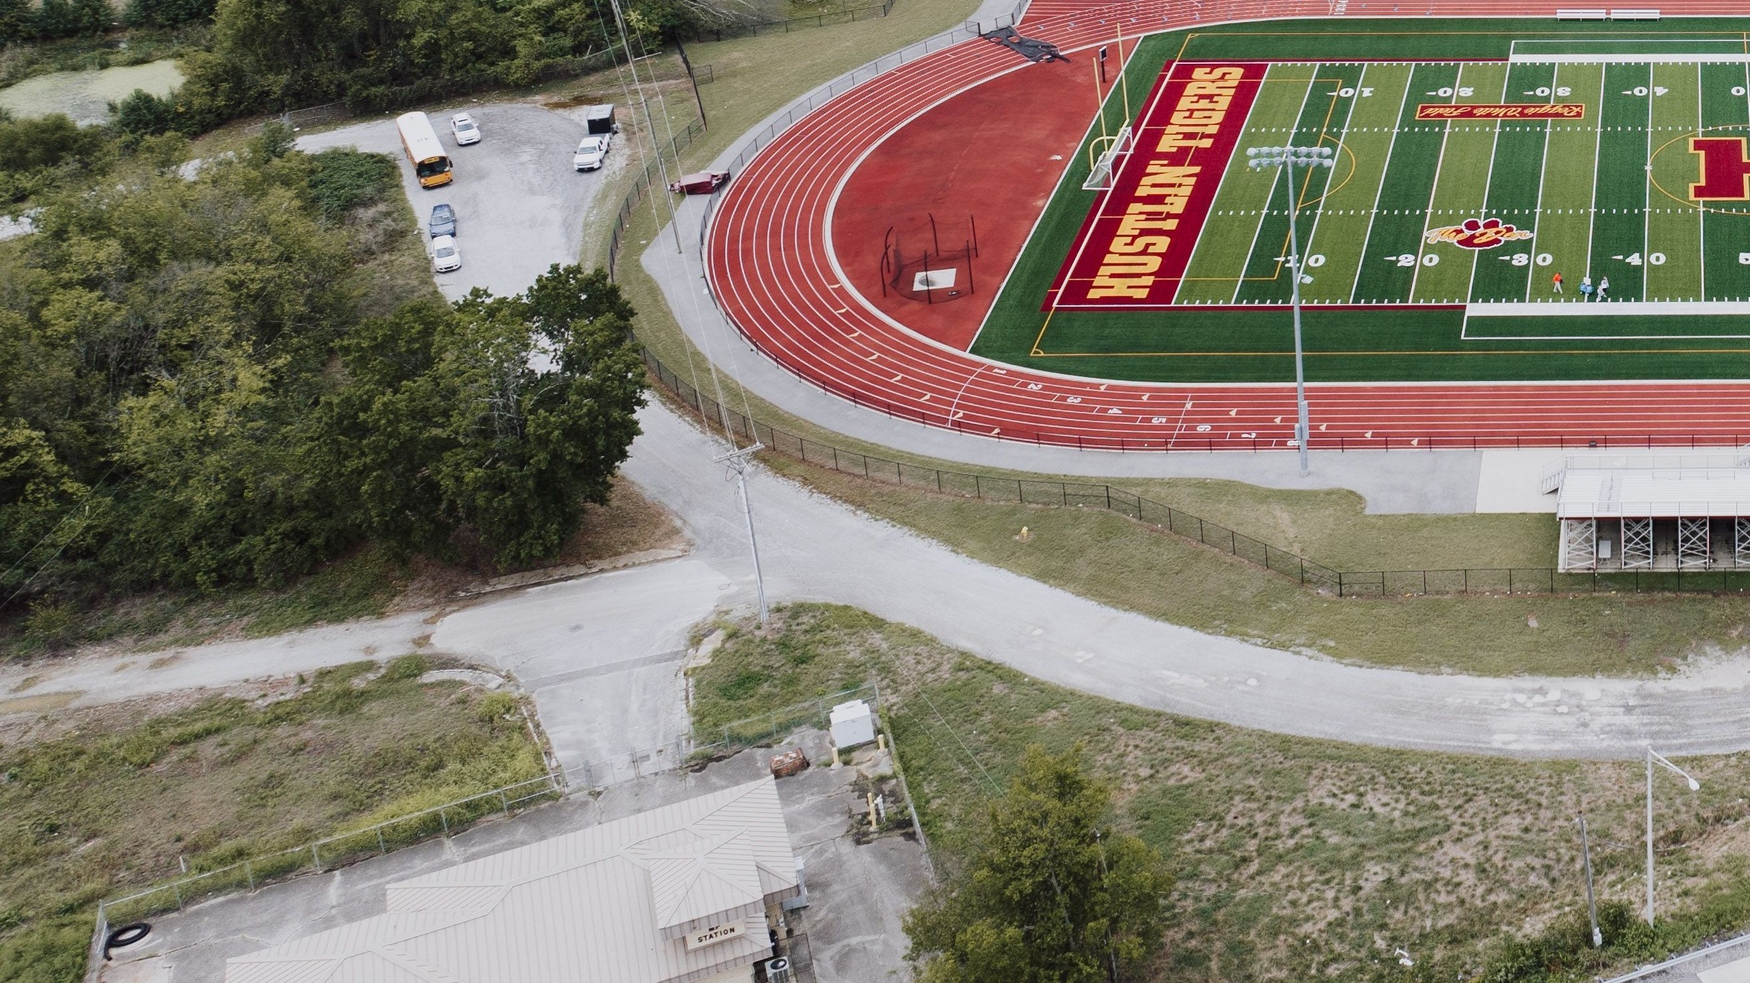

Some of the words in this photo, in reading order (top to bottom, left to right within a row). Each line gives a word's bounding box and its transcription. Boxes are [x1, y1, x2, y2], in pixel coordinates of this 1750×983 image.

[1155, 67, 1245, 153] TIGERS
[1420, 105, 1472, 117] Field
[1473, 105, 1523, 117] White
[1426, 226, 1470, 244] The
[1472, 227, 1534, 244] Den
[697, 927, 736, 943] STATION
